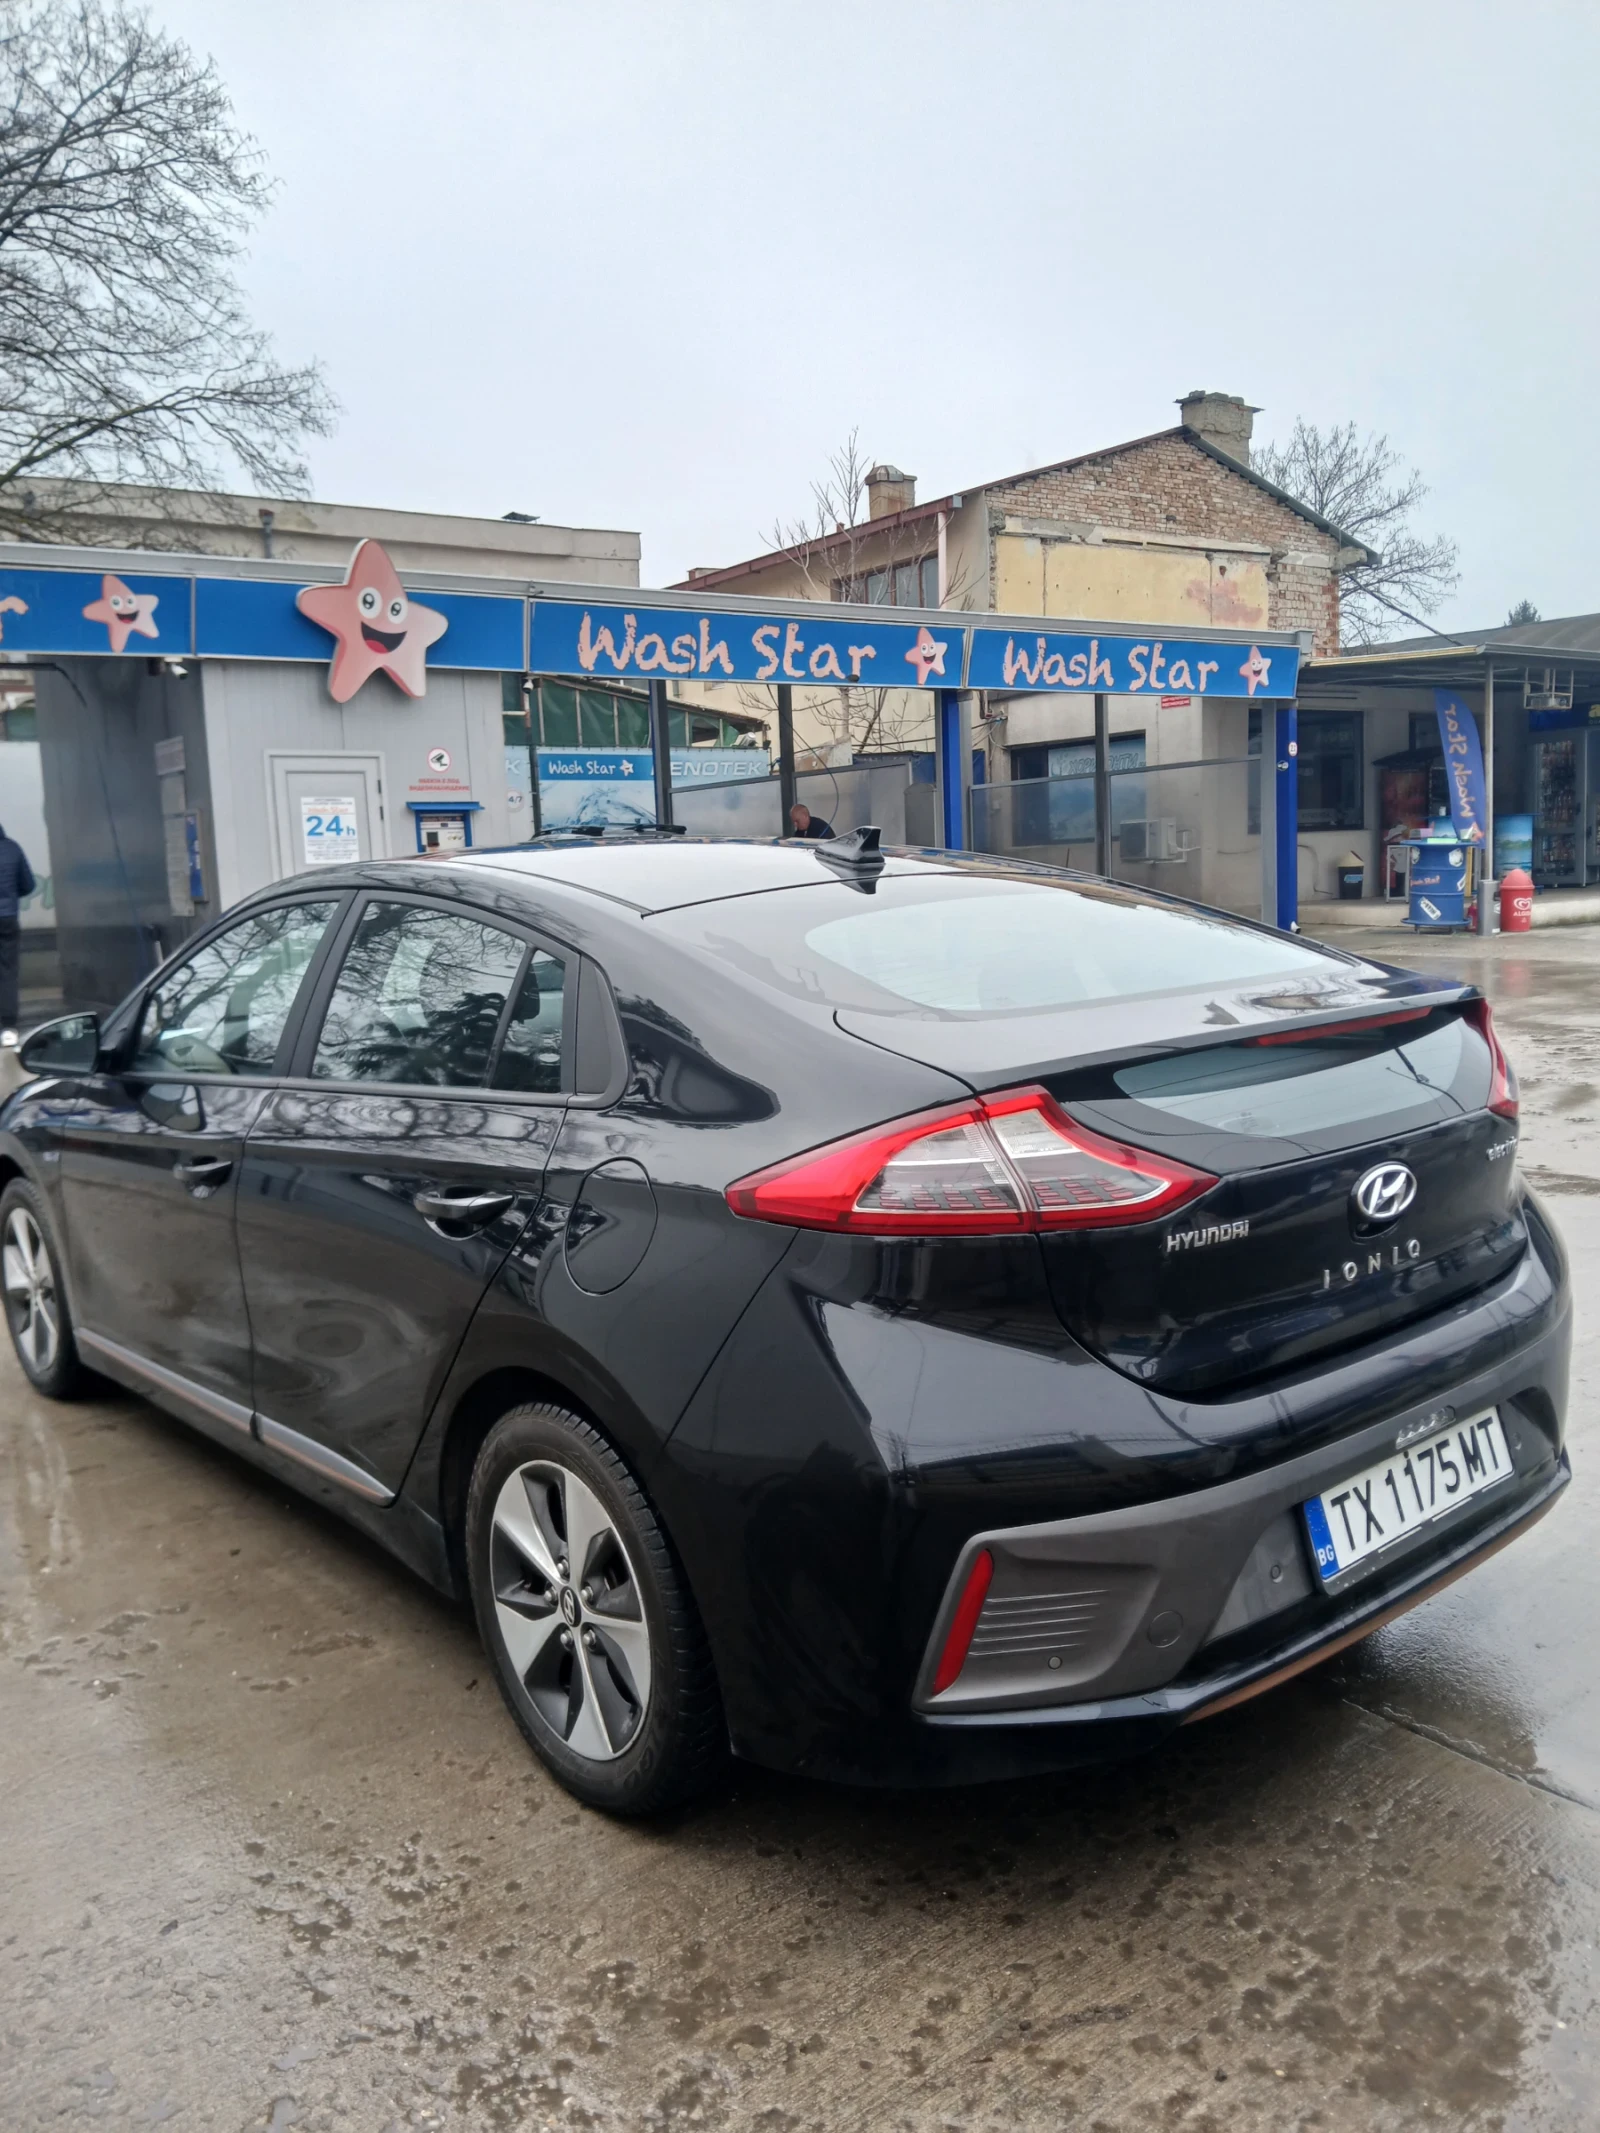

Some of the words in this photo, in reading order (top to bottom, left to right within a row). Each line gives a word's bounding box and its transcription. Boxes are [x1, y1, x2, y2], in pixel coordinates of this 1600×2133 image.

[578, 611, 734, 675] Wash
[752, 622, 877, 680] Star
[1003, 636, 1114, 687] Wash
[1128, 642, 1219, 693] Star
[549, 759, 583, 775] Wash
[587, 760, 616, 775] Star
[651, 760, 762, 776] ENOTEK
[1166, 1220, 1249, 1252] HYUNDAI
[1323, 1239, 1420, 1288] IONIQ
[1316, 1544, 1335, 1566] BG
